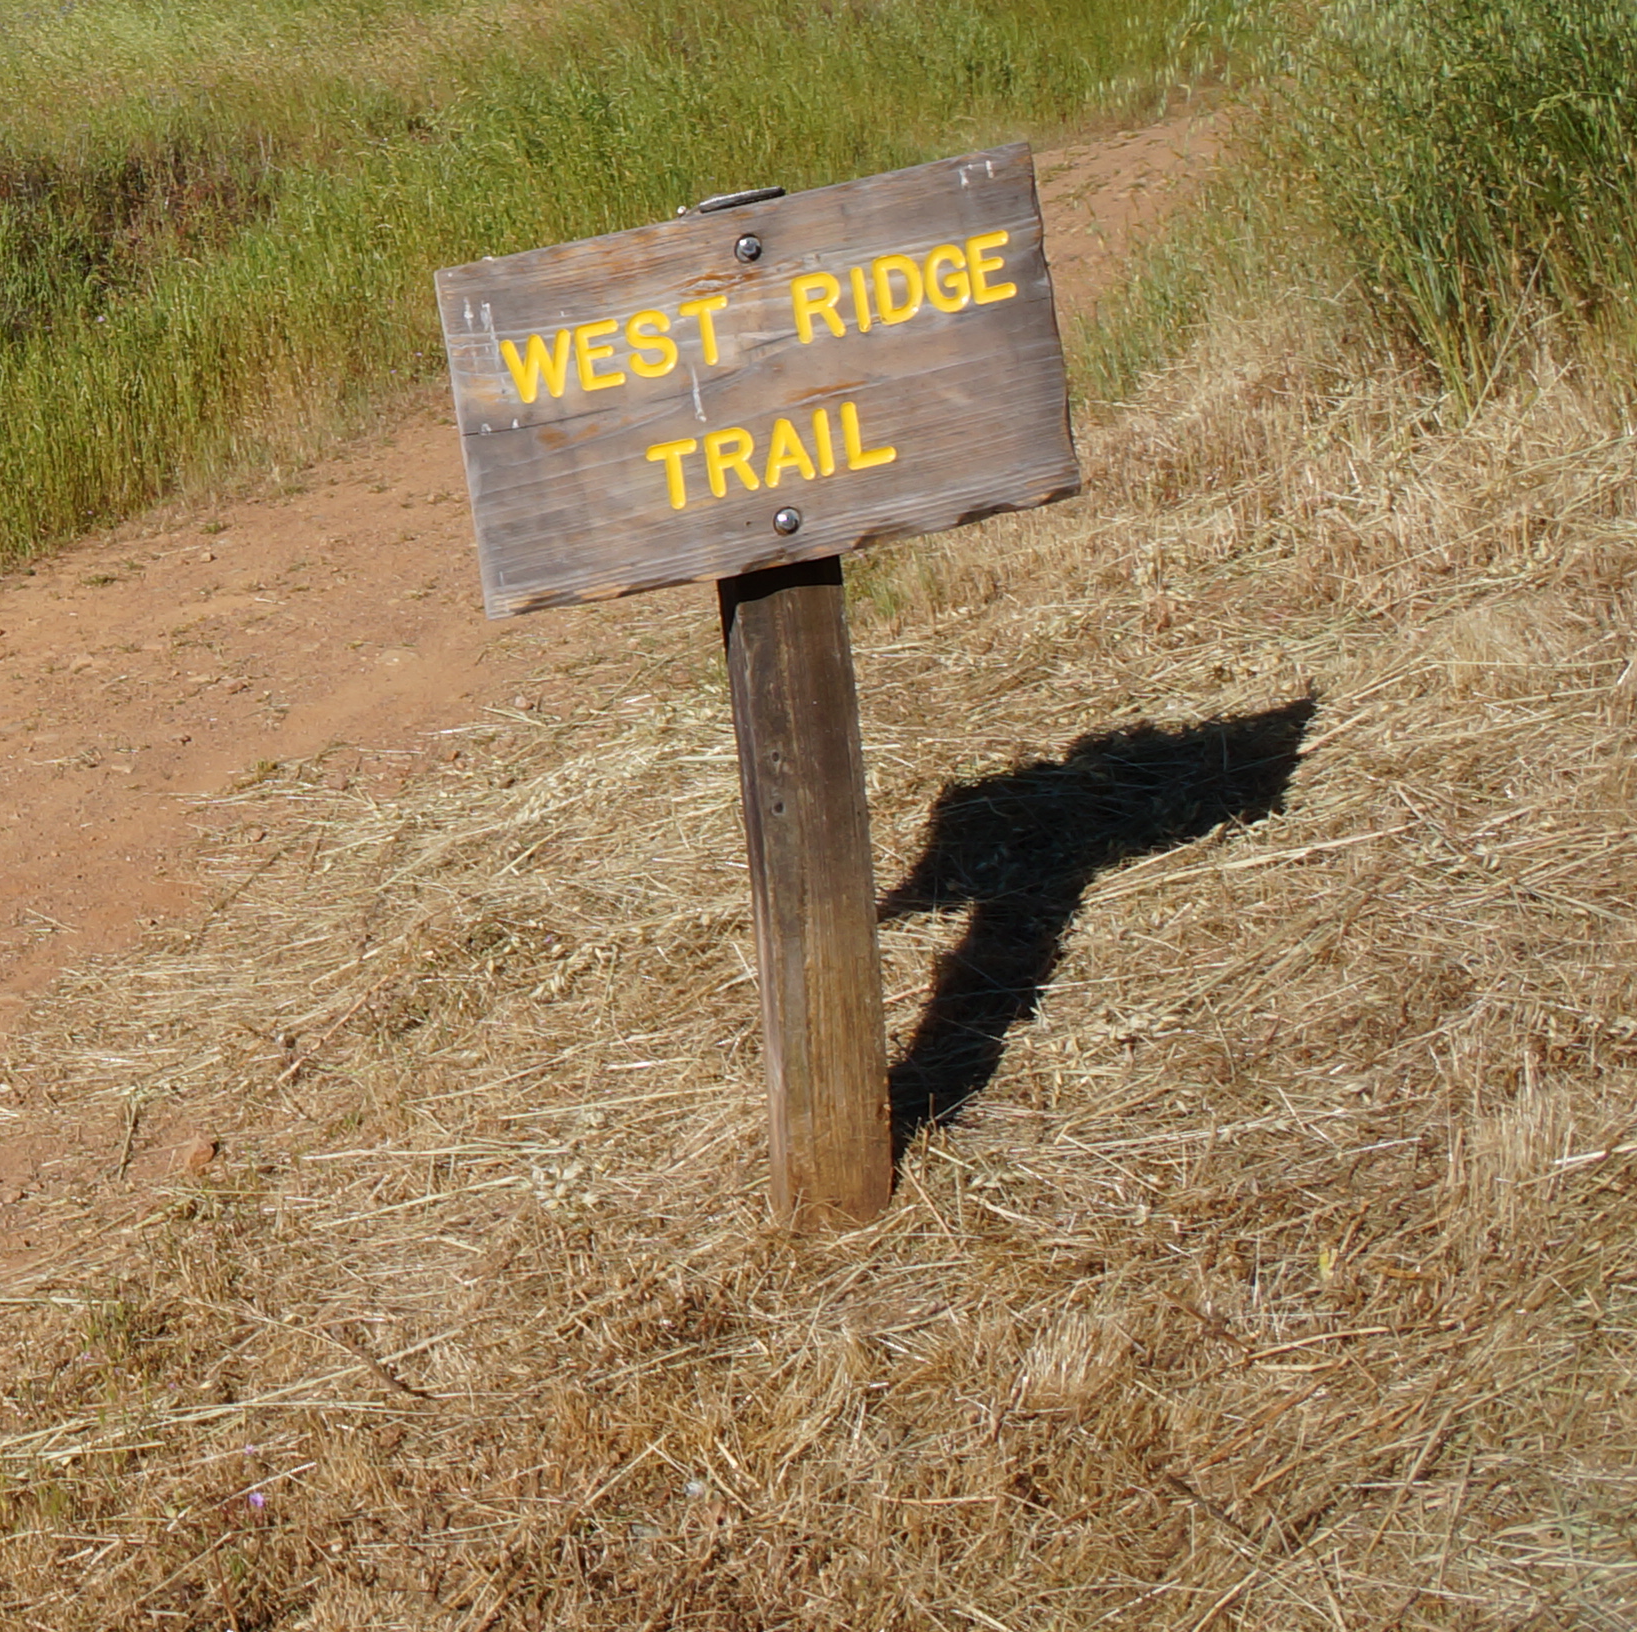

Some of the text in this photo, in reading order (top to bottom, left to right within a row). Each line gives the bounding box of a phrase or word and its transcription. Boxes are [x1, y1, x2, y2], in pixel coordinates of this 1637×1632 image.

[499, 229, 1018, 404] WEST RIDGE
[645, 401, 898, 511] TRAIL
